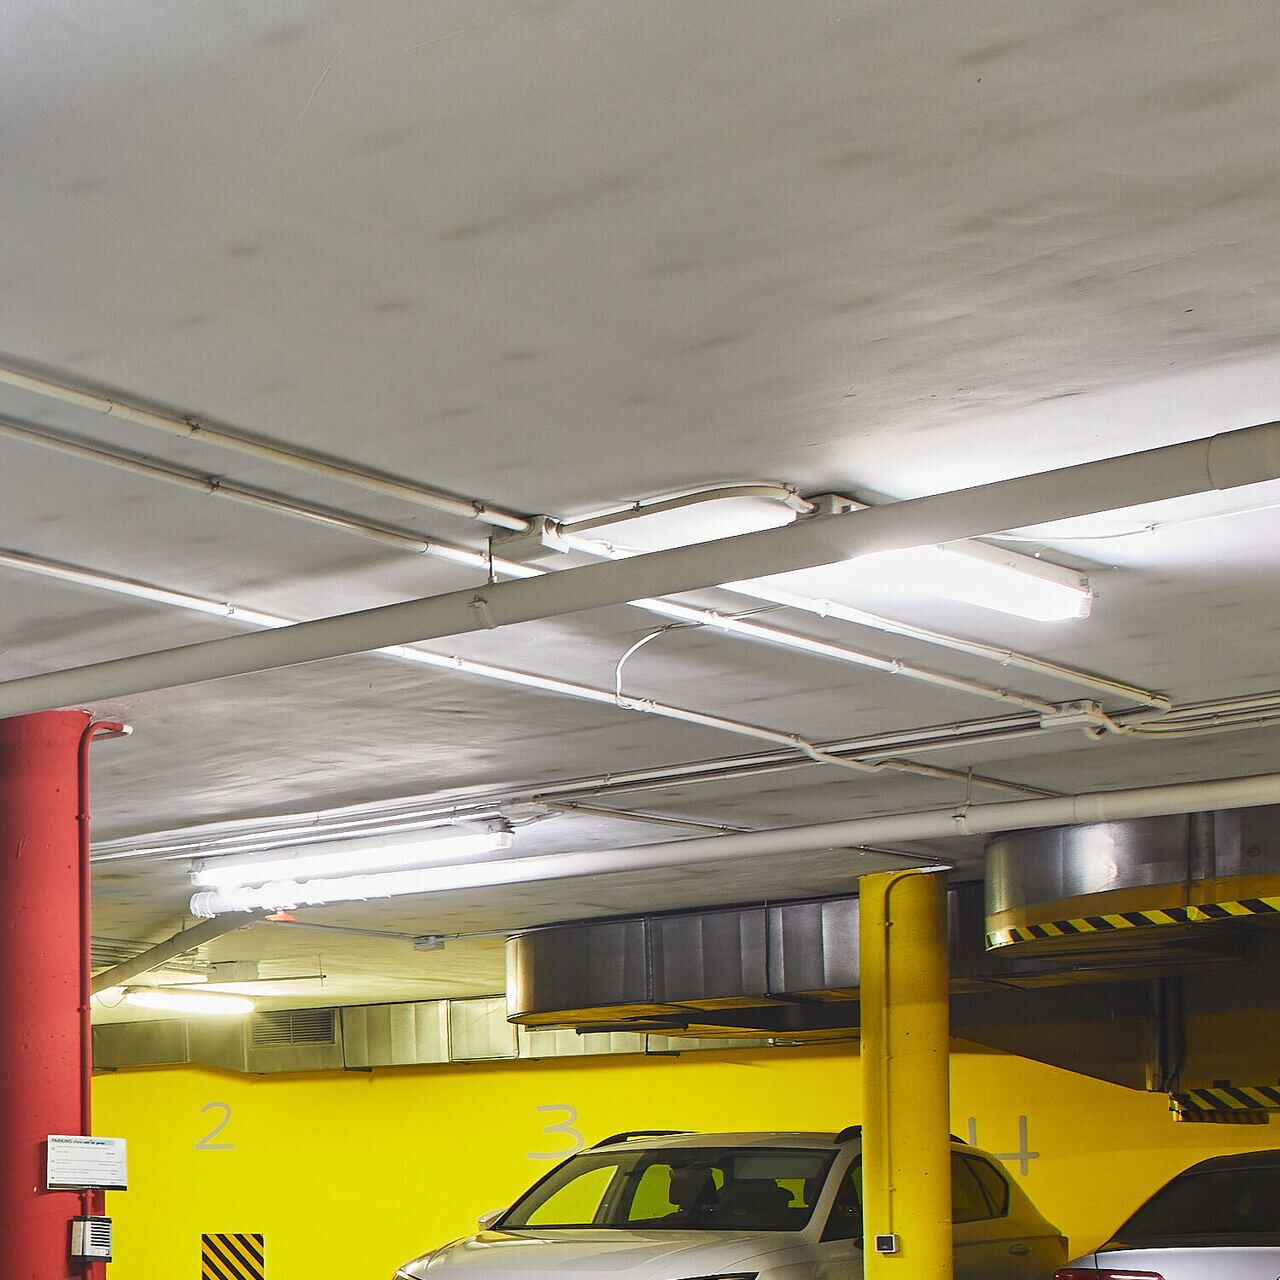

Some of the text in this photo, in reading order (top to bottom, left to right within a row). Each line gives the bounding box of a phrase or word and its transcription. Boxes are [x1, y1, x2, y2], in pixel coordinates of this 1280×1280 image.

[194, 1101, 235, 1150] 2
[527, 1104, 584, 1159] 3
[968, 1115, 1040, 1176] 4
